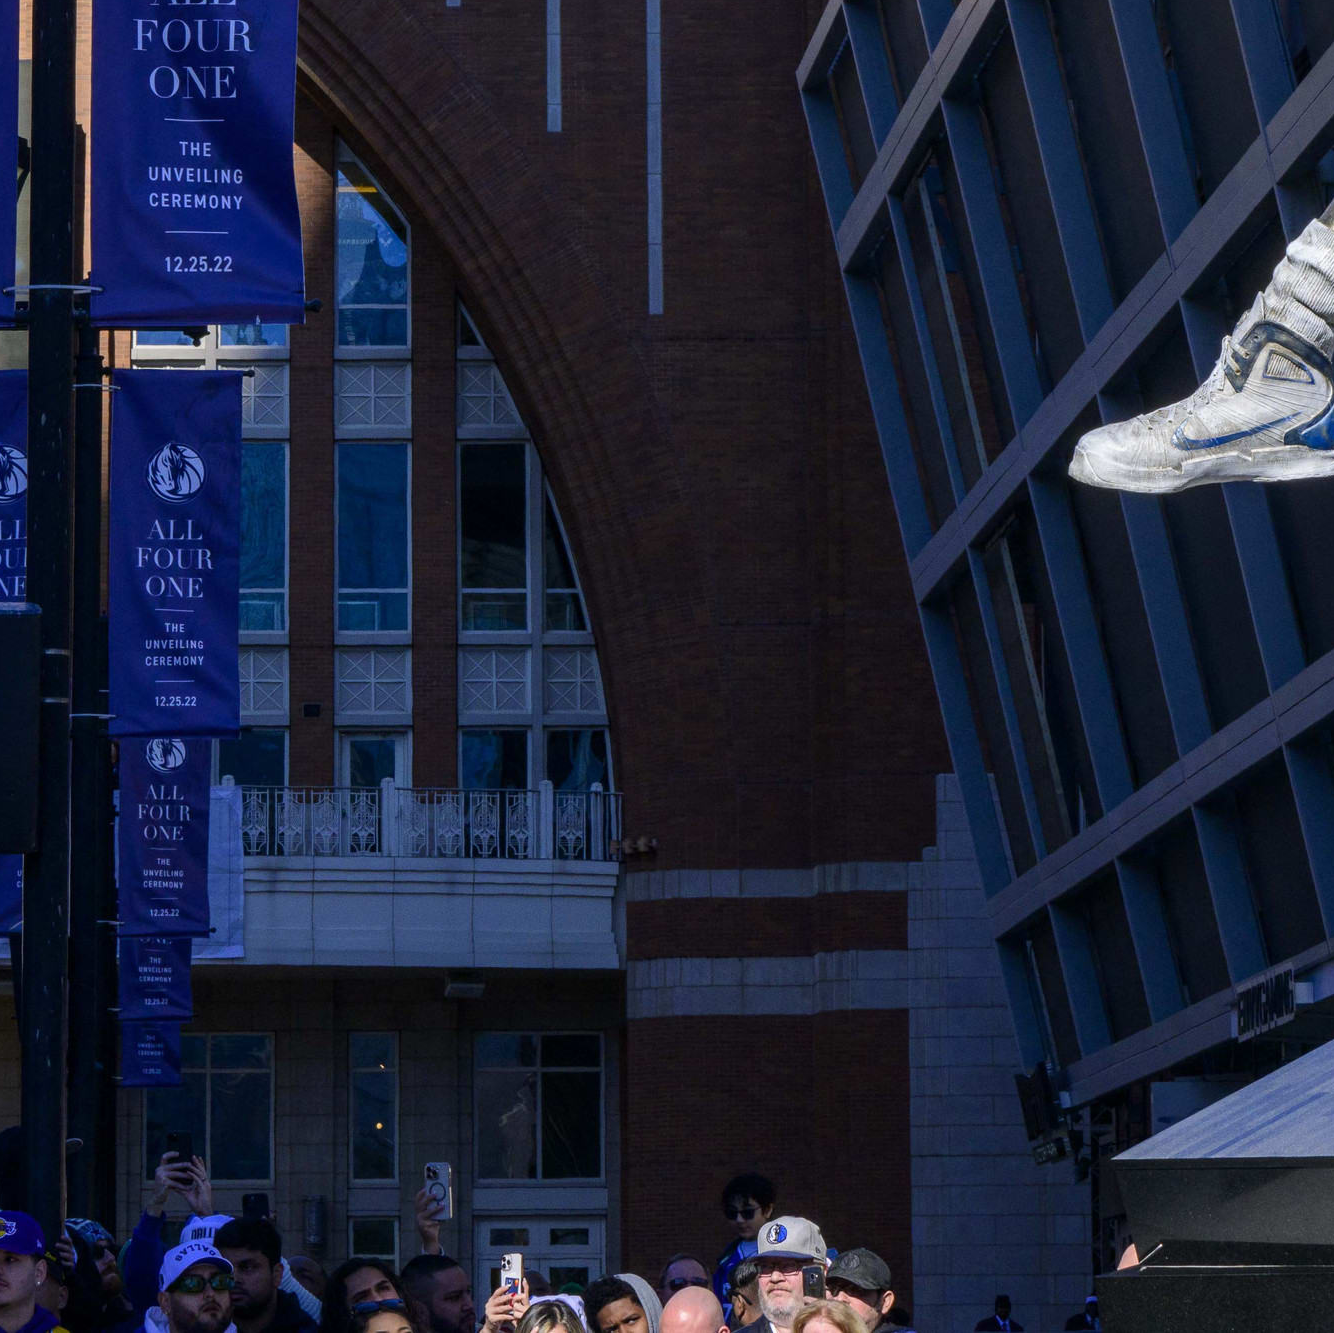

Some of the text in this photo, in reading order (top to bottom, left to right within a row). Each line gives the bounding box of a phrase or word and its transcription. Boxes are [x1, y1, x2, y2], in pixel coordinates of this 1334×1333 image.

[133, 18, 255, 52] FOUR
[148, 65, 237, 100] ONE
[179, 141, 211, 157] THE
[148, 167, 243, 185] UNVEILING
[149, 193, 243, 210] CEREMONY
[165, 256, 232, 273] 12.25.22
[147, 519, 203, 541] ALL
[135, 547, 214, 570] FOUR
[145, 576, 204, 598] ONE
[165, 623, 185, 633] THE
[145, 639, 204, 650] UNVEILING
[145, 656, 204, 666] CEREMONY
[155, 696, 197, 707] 12.25.22
[145, 784, 184, 801] ALL
[137, 804, 190, 822] FOUR
[143, 825, 184, 841] ONE
[157, 858, 171, 866] THE
[143, 869, 184, 878] UNVEILING
[143, 881, 184, 889] CEREMONY
[150, 909, 180, 917] 12.25.22
